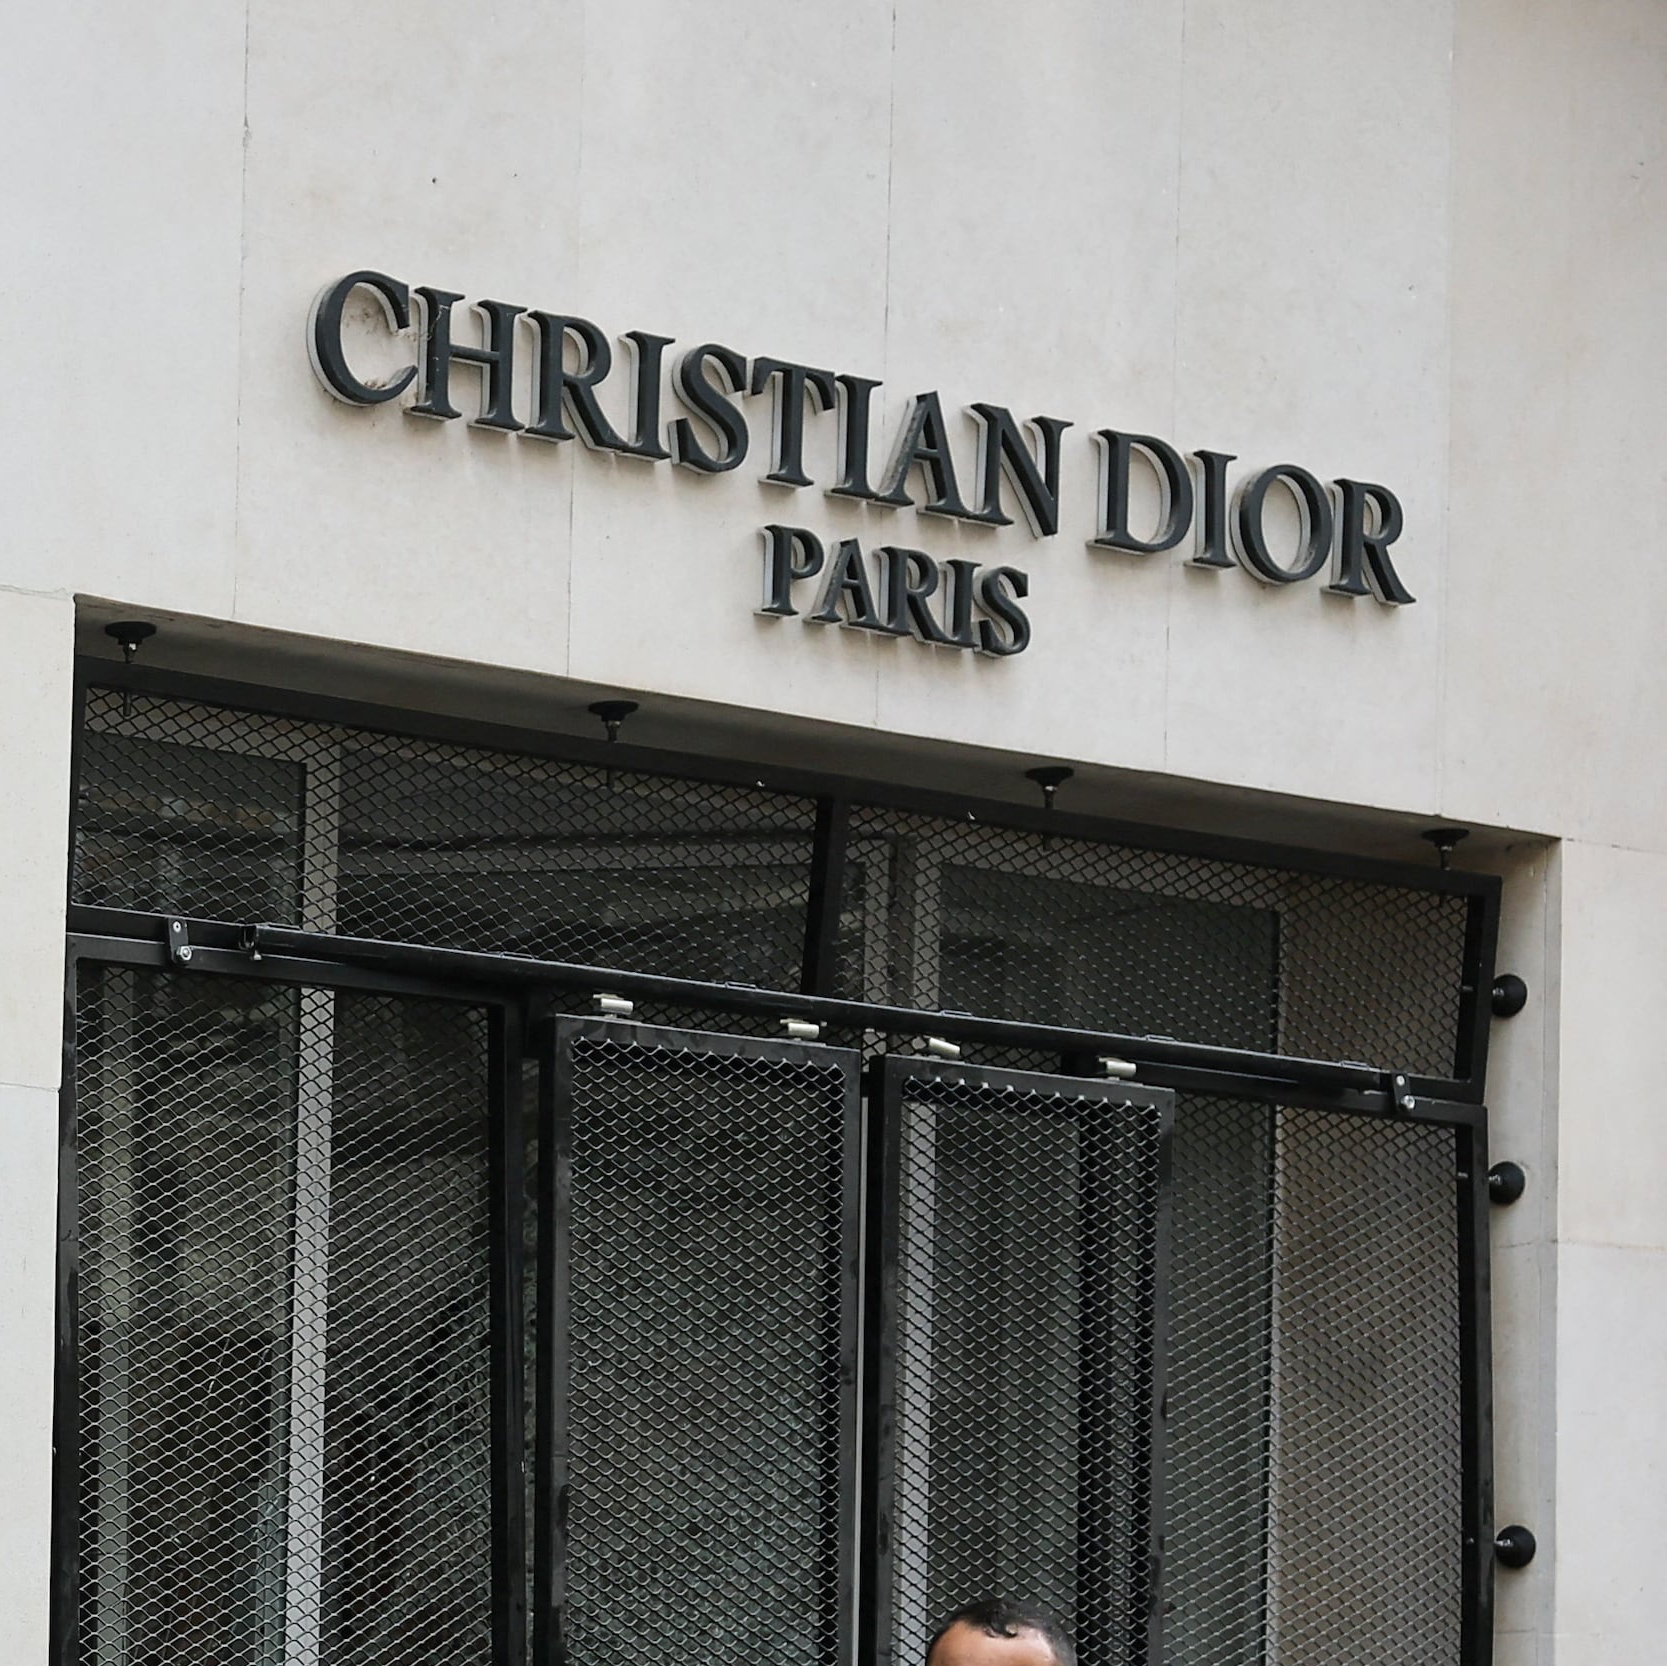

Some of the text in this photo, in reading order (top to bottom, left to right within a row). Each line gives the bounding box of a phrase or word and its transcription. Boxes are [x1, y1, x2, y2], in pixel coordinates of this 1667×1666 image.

[309, 270, 1416, 605] CHRISTIAN DIOR
[756, 524, 1031, 660] PARIS
